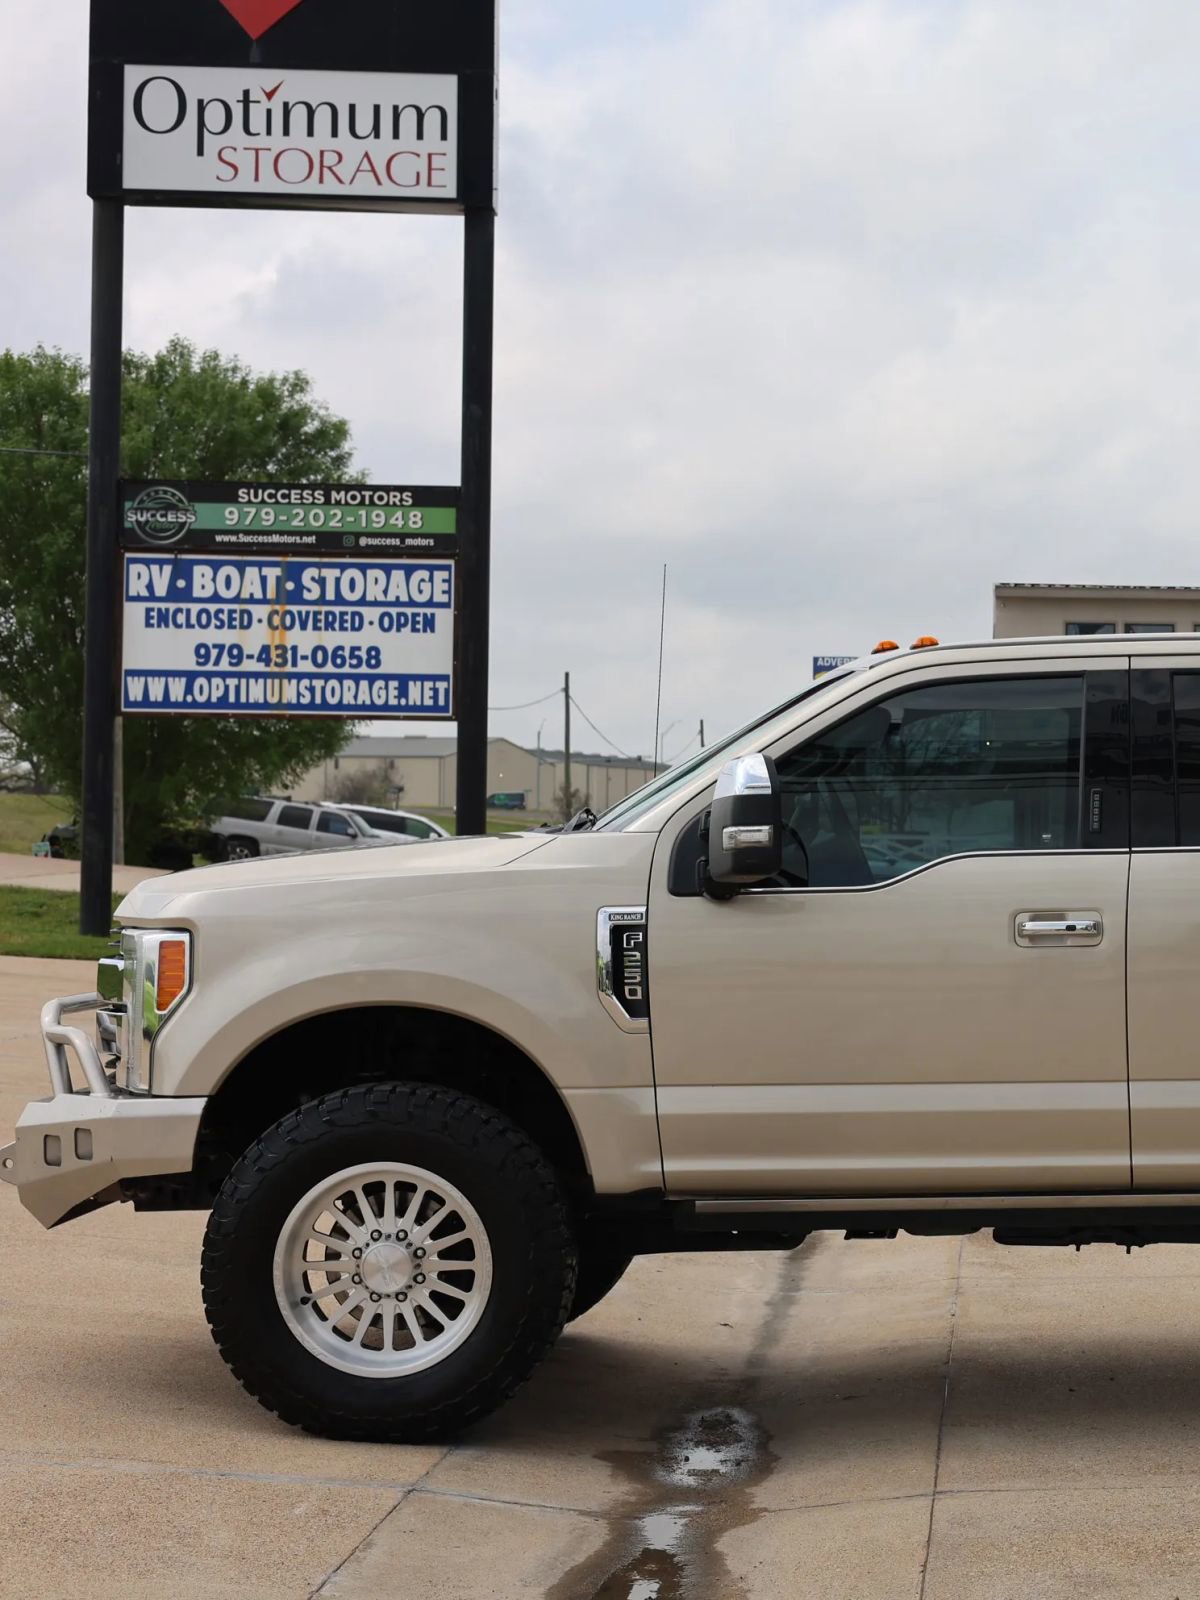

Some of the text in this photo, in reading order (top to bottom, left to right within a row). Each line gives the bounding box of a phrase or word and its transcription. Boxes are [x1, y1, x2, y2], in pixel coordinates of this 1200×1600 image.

[132, 76, 448, 157] Optimum
[215, 145, 448, 188] STORAGE
[238, 488, 413, 506] SUCCESS MOTORS
[127, 509, 196, 523] SUCCESS
[224, 507, 423, 529] 979-202-1948
[215, 533, 316, 545] www.SuccessMotors.net
[359, 535, 435, 547] @success_motors
[128, 563, 449, 603] RV BOAT STORAGE
[144, 607, 436, 634] ENCLOSED COVERED OPEN
[194, 642, 382, 669] 979-431-0658
[817, 657, 853, 667] ADVER
[126, 676, 448, 707] WWW.OPTIMUMSTORAGE.NET
